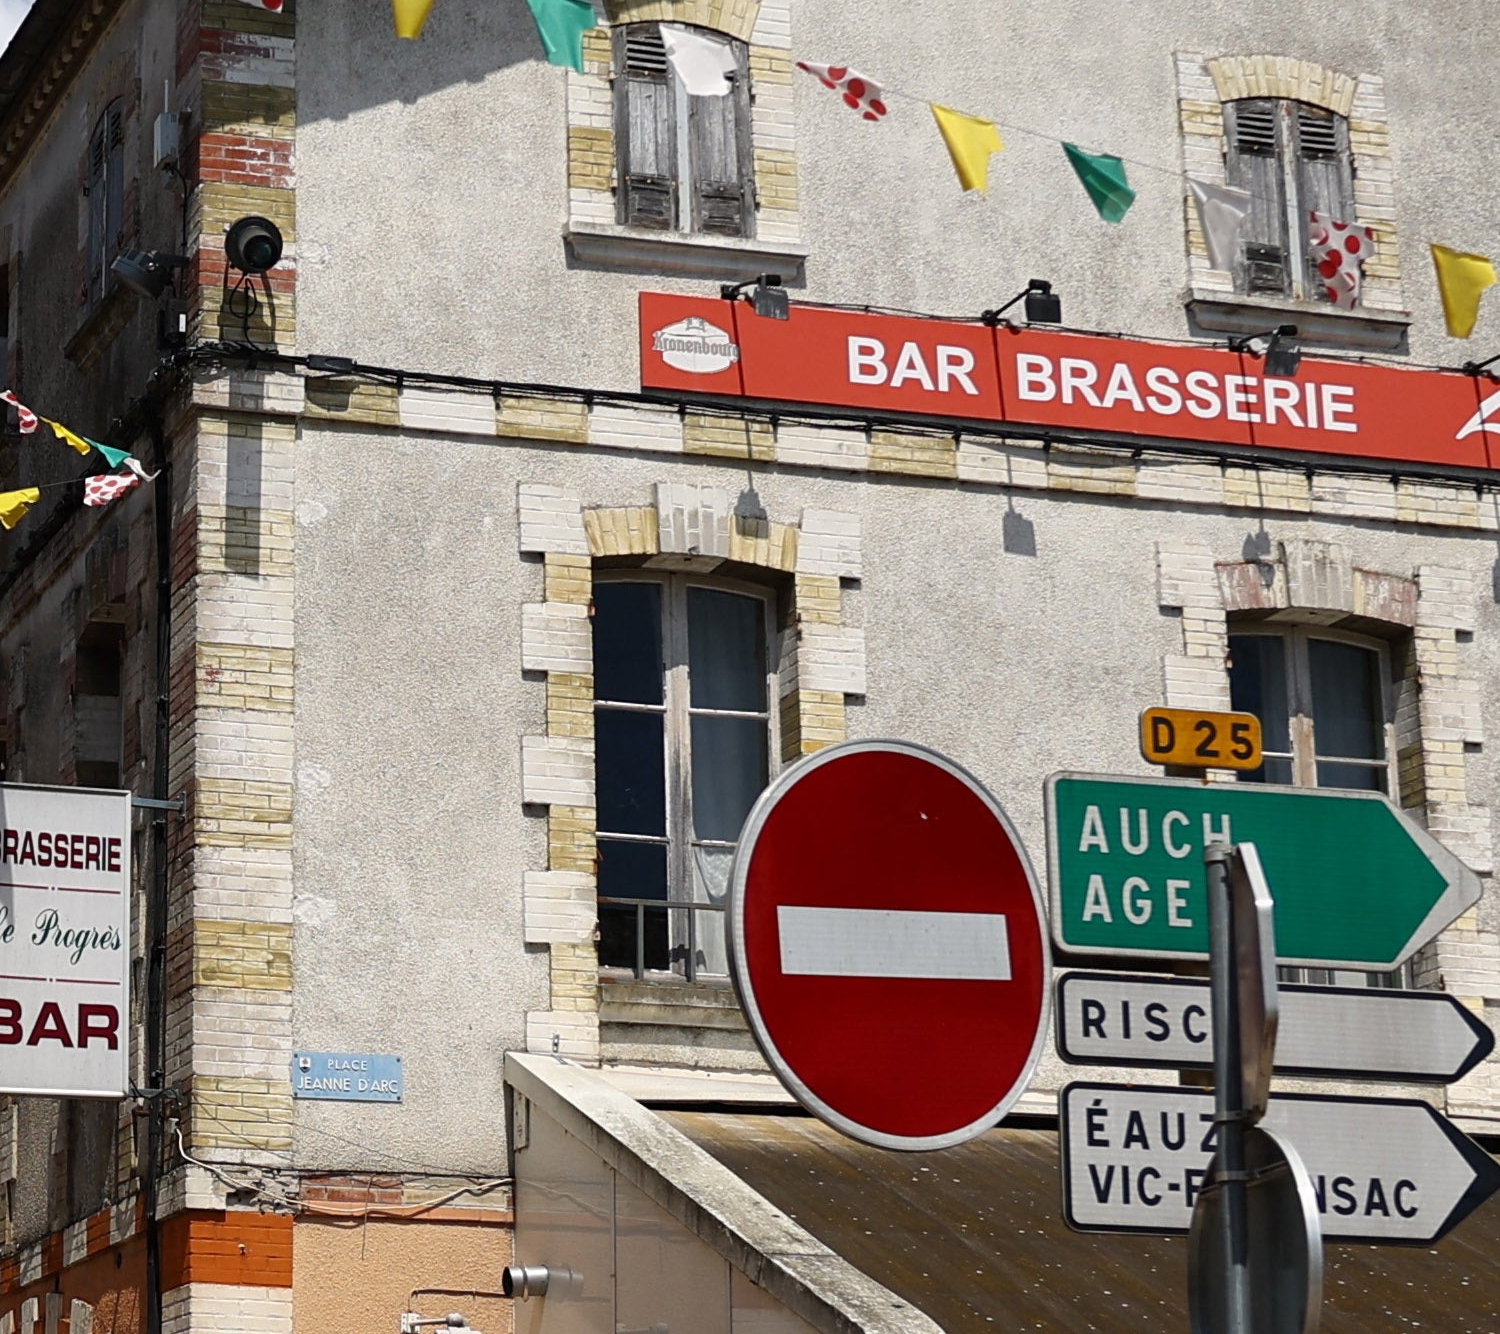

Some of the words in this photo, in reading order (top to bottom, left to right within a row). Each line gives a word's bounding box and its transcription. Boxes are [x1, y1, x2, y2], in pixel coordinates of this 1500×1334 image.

[848, 335, 979, 396] BAR
[1016, 353, 1358, 433] BRASSERIE
[1152, 717, 1175, 753] D
[1194, 720, 1253, 760] 25
[1079, 805, 1231, 859] AUCH
[1082, 874, 1193, 928] AGE
[32, 908, 122, 966] Progrès
[1081, 998, 1208, 1044] RISC
[297, 1076, 351, 1092] JEANNE
[358, 1078, 399, 1094] D'ARC
[327, 1059, 368, 1072] PLACE
[1086, 1100, 1219, 1154] ÉAUZ
